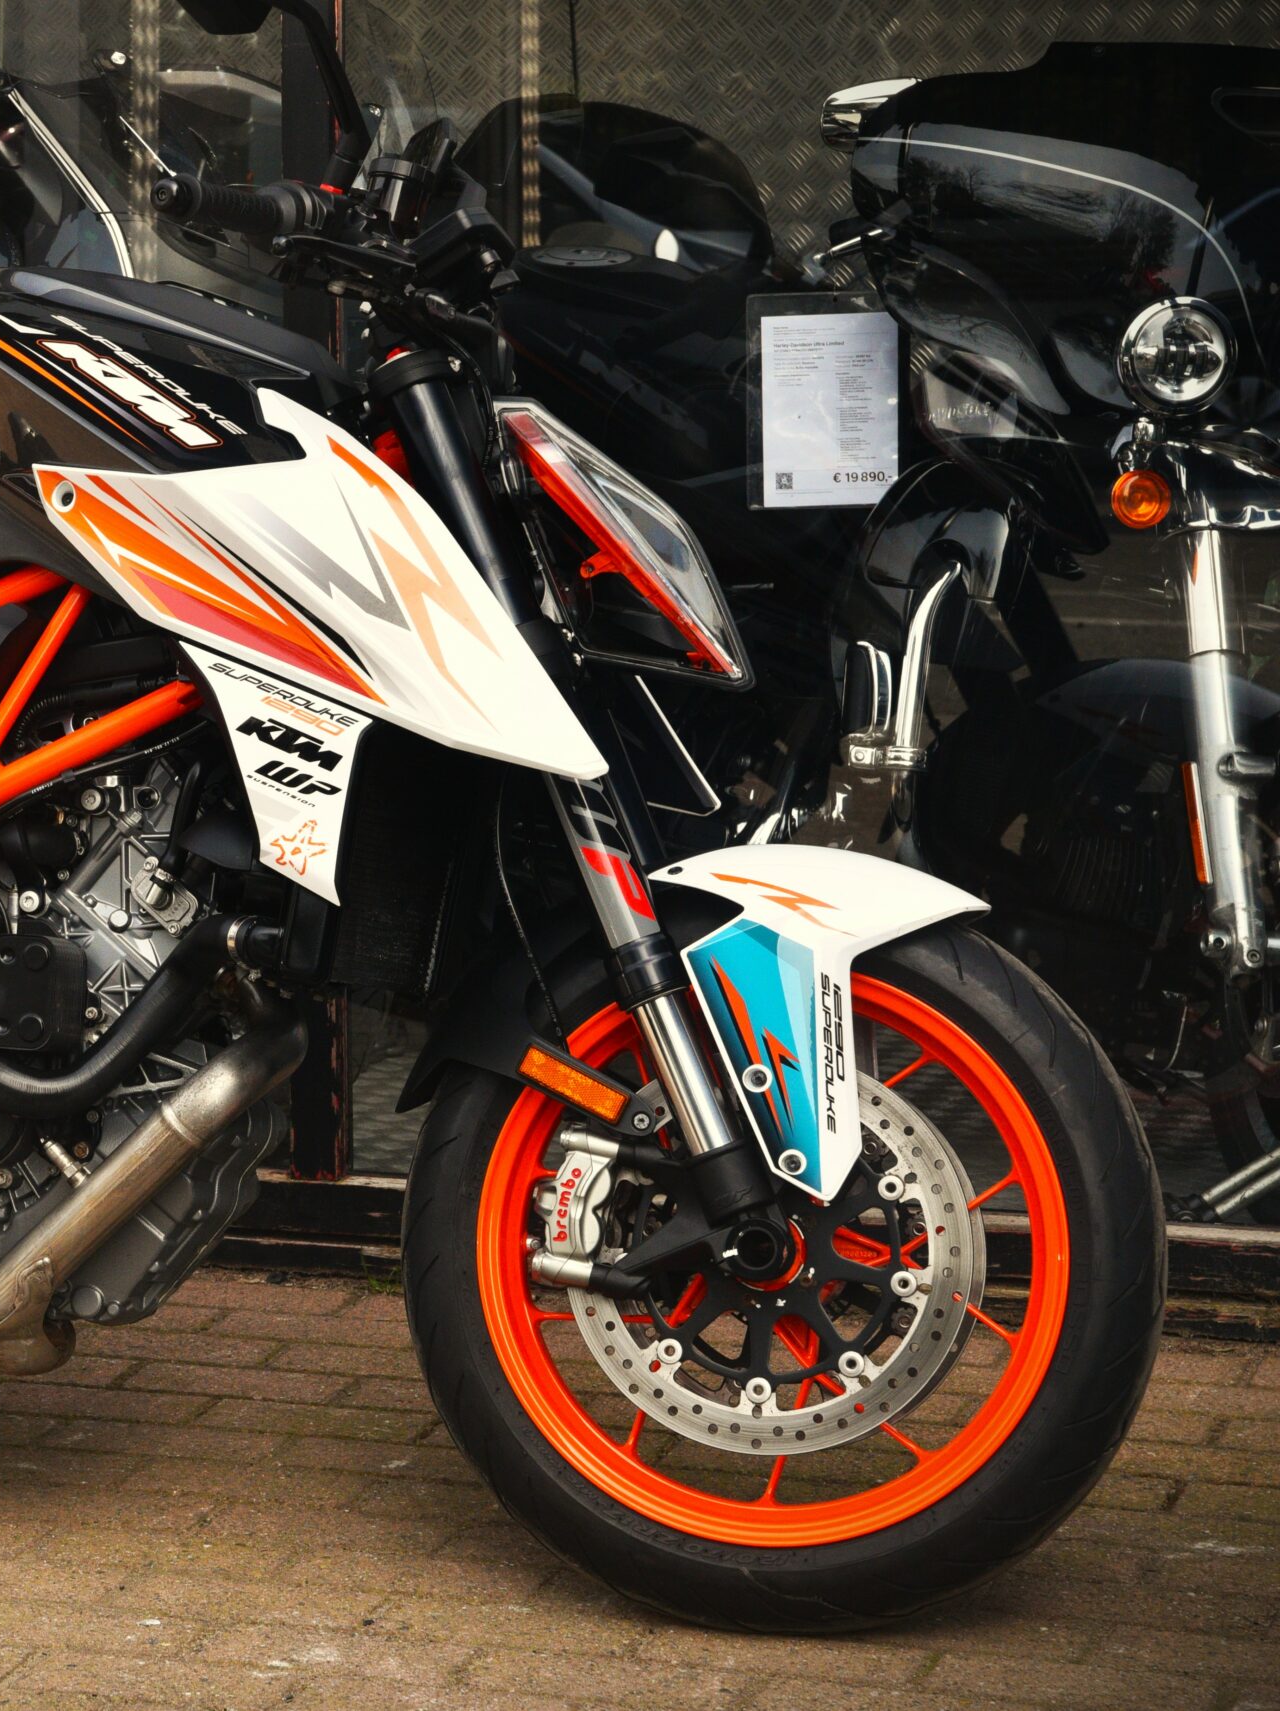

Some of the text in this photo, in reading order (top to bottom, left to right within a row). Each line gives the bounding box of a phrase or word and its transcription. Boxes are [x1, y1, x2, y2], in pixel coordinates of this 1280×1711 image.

[38, 339, 222, 448] KTM
[51, 314, 248, 435] SUPERDUKE
[208, 662, 359, 727] SUPERDUKE
[260, 696, 345, 736] 1290
[236, 716, 344, 772] KTM
[254, 760, 343, 796] WP
[820, 972, 837, 1134] SUPERDUKE
[833, 983, 846, 1082] 1290
[553, 1167, 582, 1242] brembo
